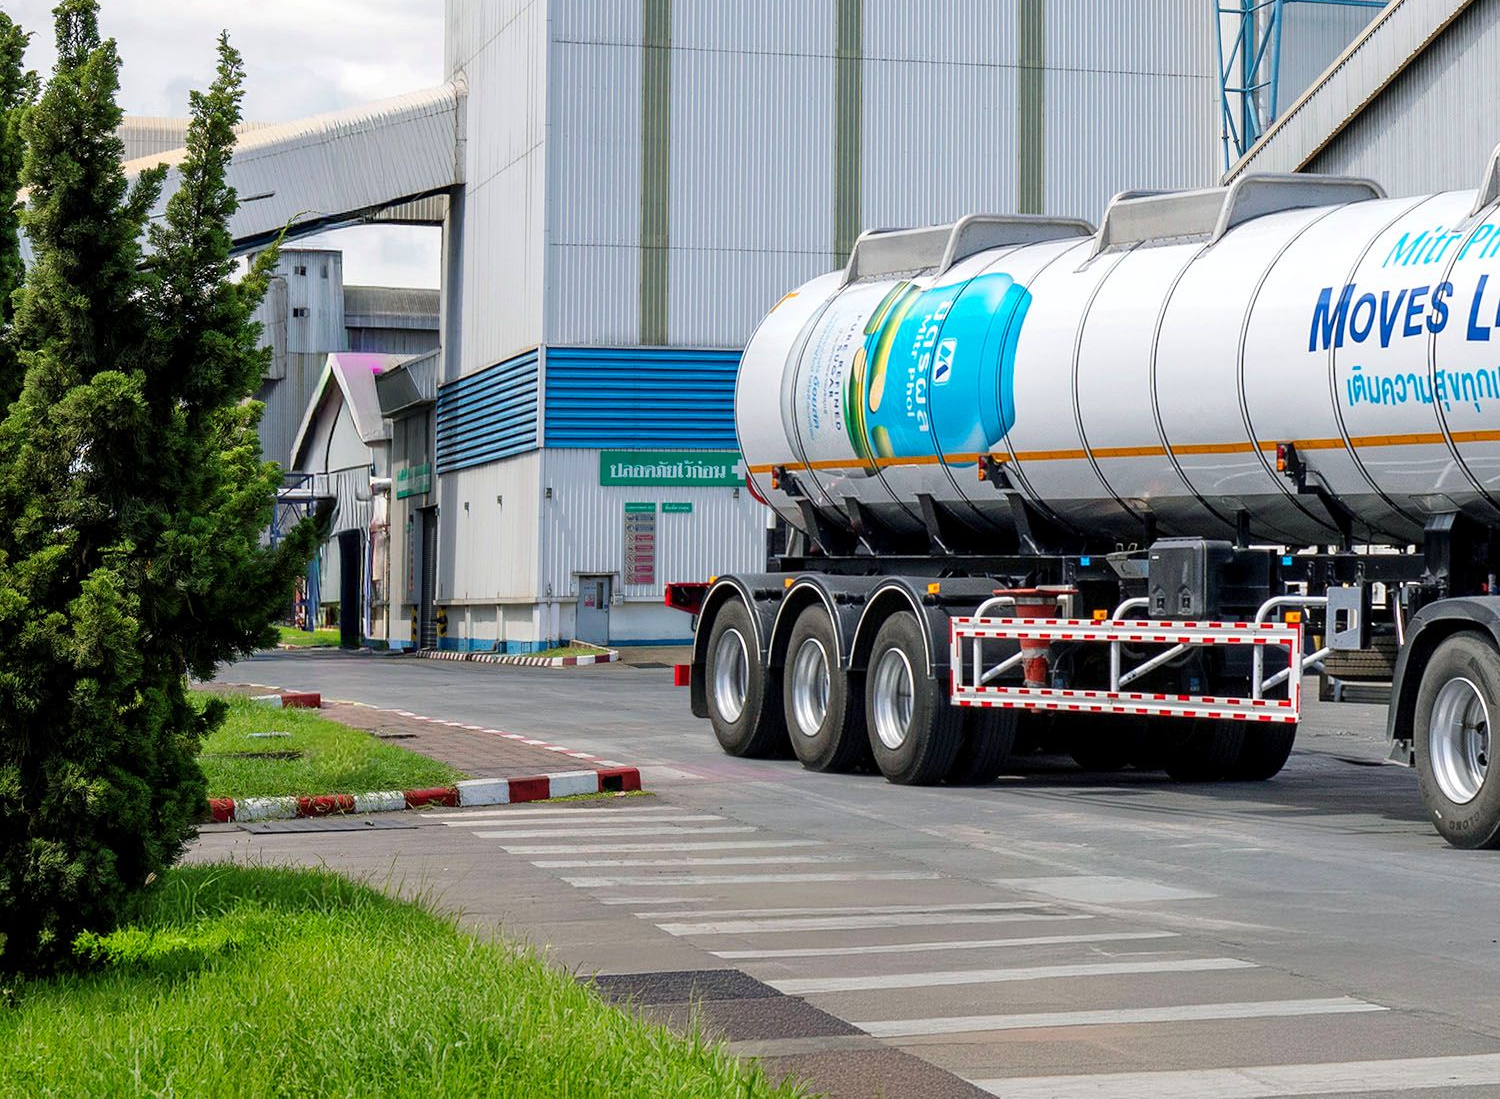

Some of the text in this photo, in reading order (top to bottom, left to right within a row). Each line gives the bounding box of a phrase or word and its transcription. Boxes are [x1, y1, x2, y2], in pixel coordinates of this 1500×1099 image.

[1382, 225, 1463, 268] Mitr
[1308, 281, 1453, 352] MOVES
[610, 460, 726, 479] ปลอดภัยไว้ก่อน
